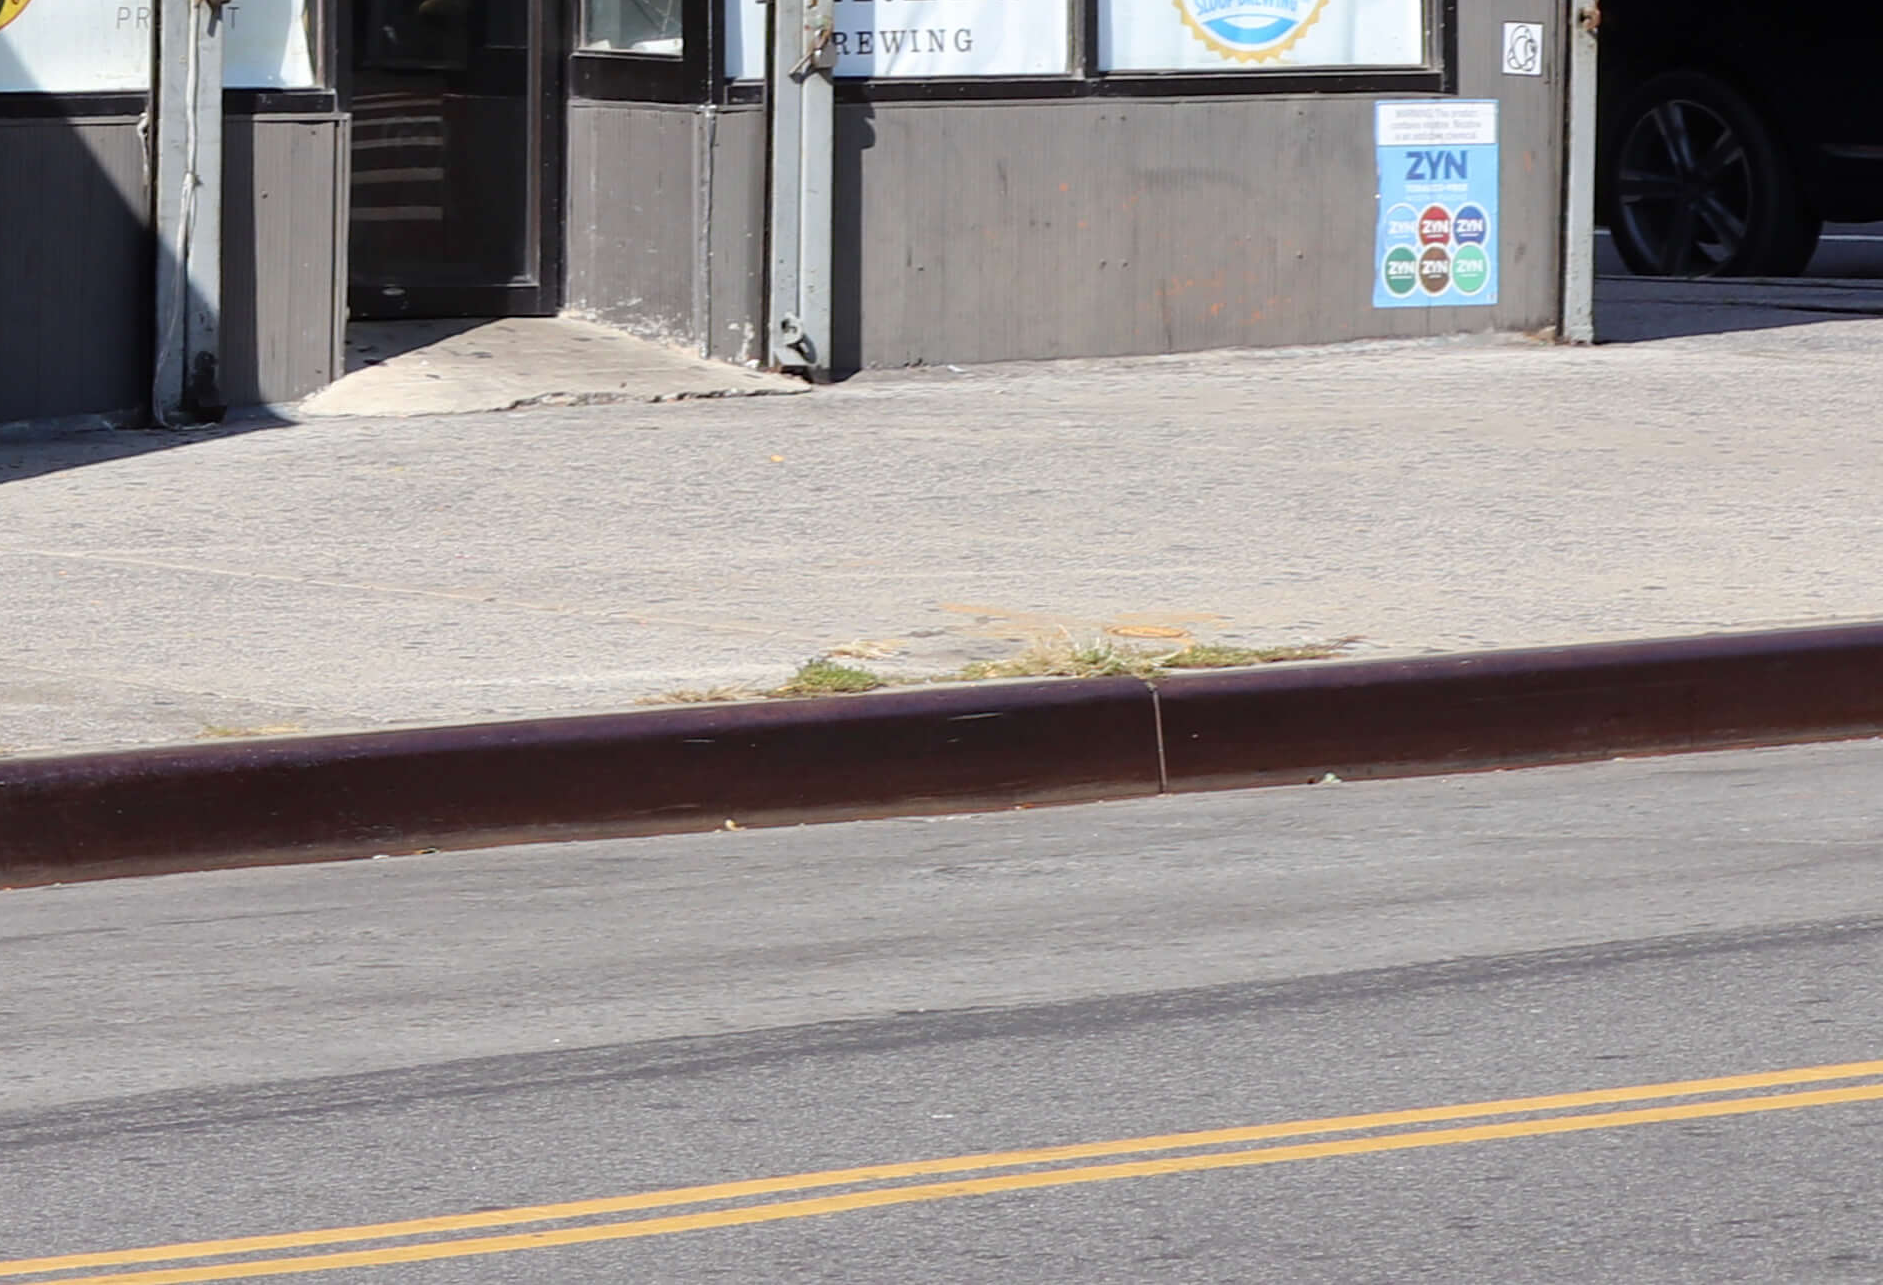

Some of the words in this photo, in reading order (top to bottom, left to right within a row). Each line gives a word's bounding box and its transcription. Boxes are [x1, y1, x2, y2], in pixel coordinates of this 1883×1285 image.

[1404, 149, 1469, 181] ZYN
[1388, 220, 1415, 234] ZYN
[1421, 219, 1450, 234] ZYN
[1455, 218, 1483, 233] ZYN
[1388, 261, 1415, 275] ZYN
[1421, 260, 1449, 275] ZYN
[1455, 259, 1483, 274] ZYN
